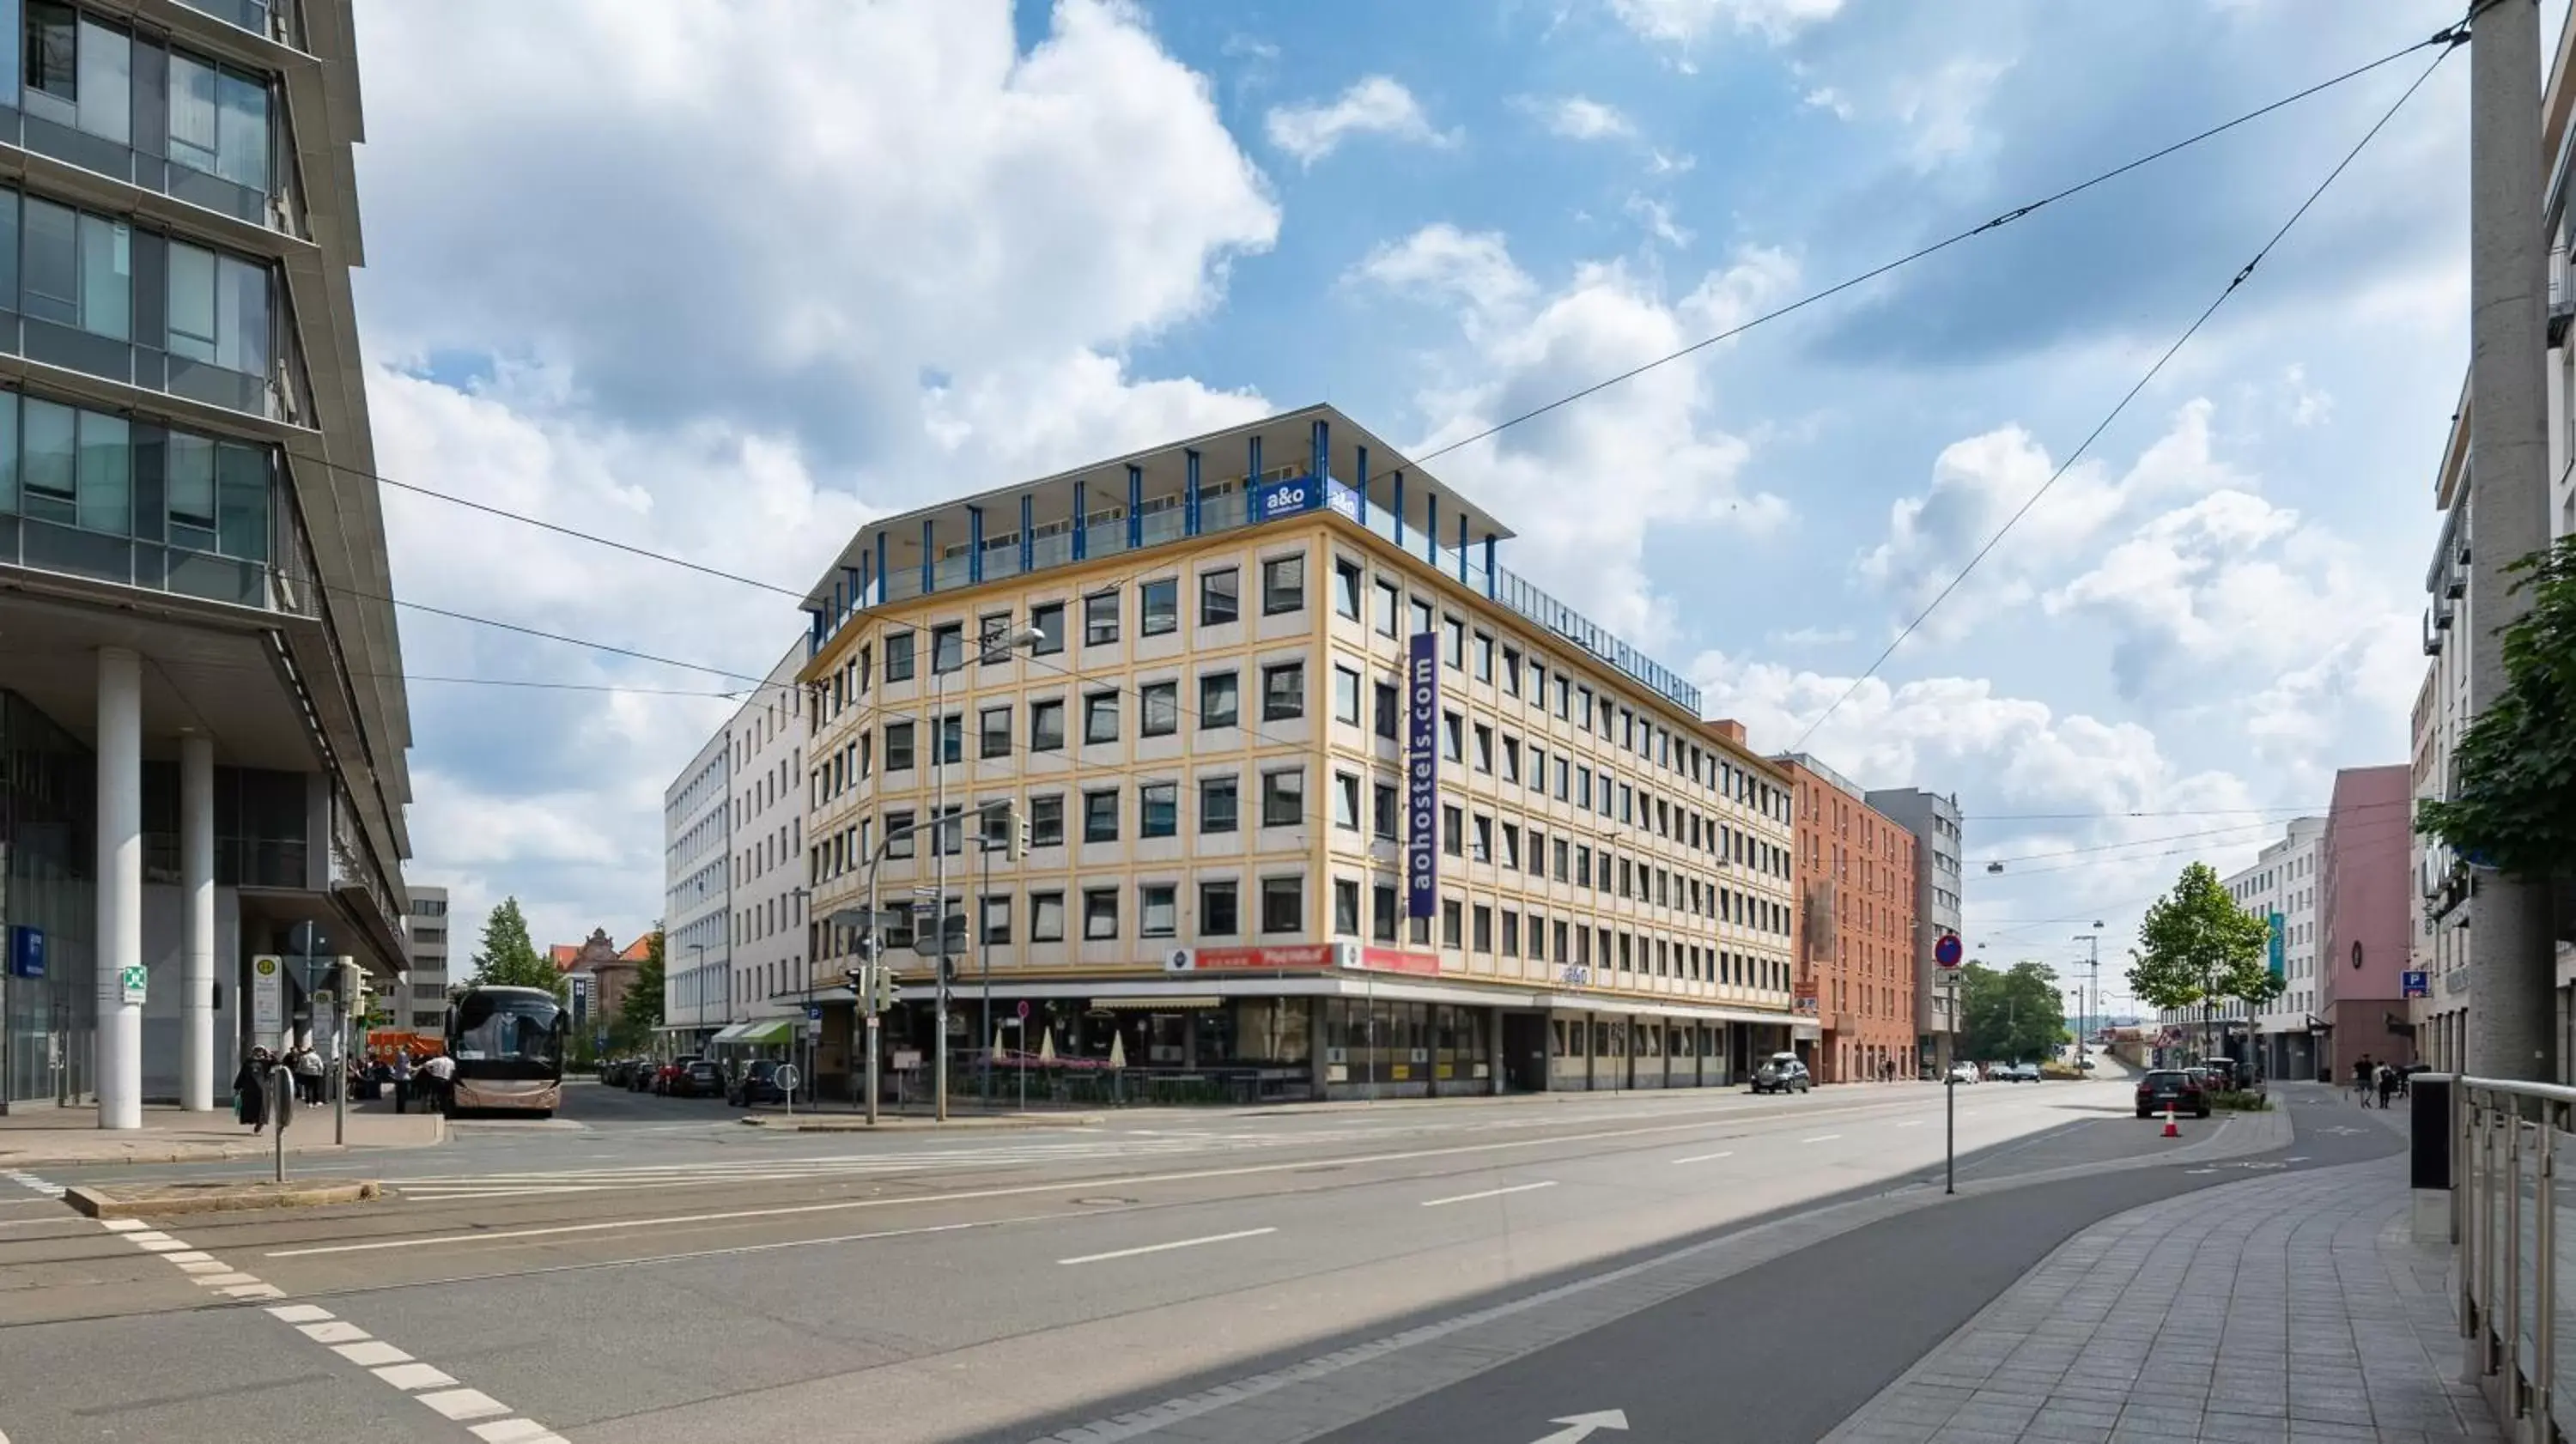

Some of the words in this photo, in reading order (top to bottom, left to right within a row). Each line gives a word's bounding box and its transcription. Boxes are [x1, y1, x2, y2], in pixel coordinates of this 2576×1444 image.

[1267, 487, 1304, 508] a&o
[1411, 658, 1431, 889] aohostels.com
[2410, 974, 2421, 985] P
